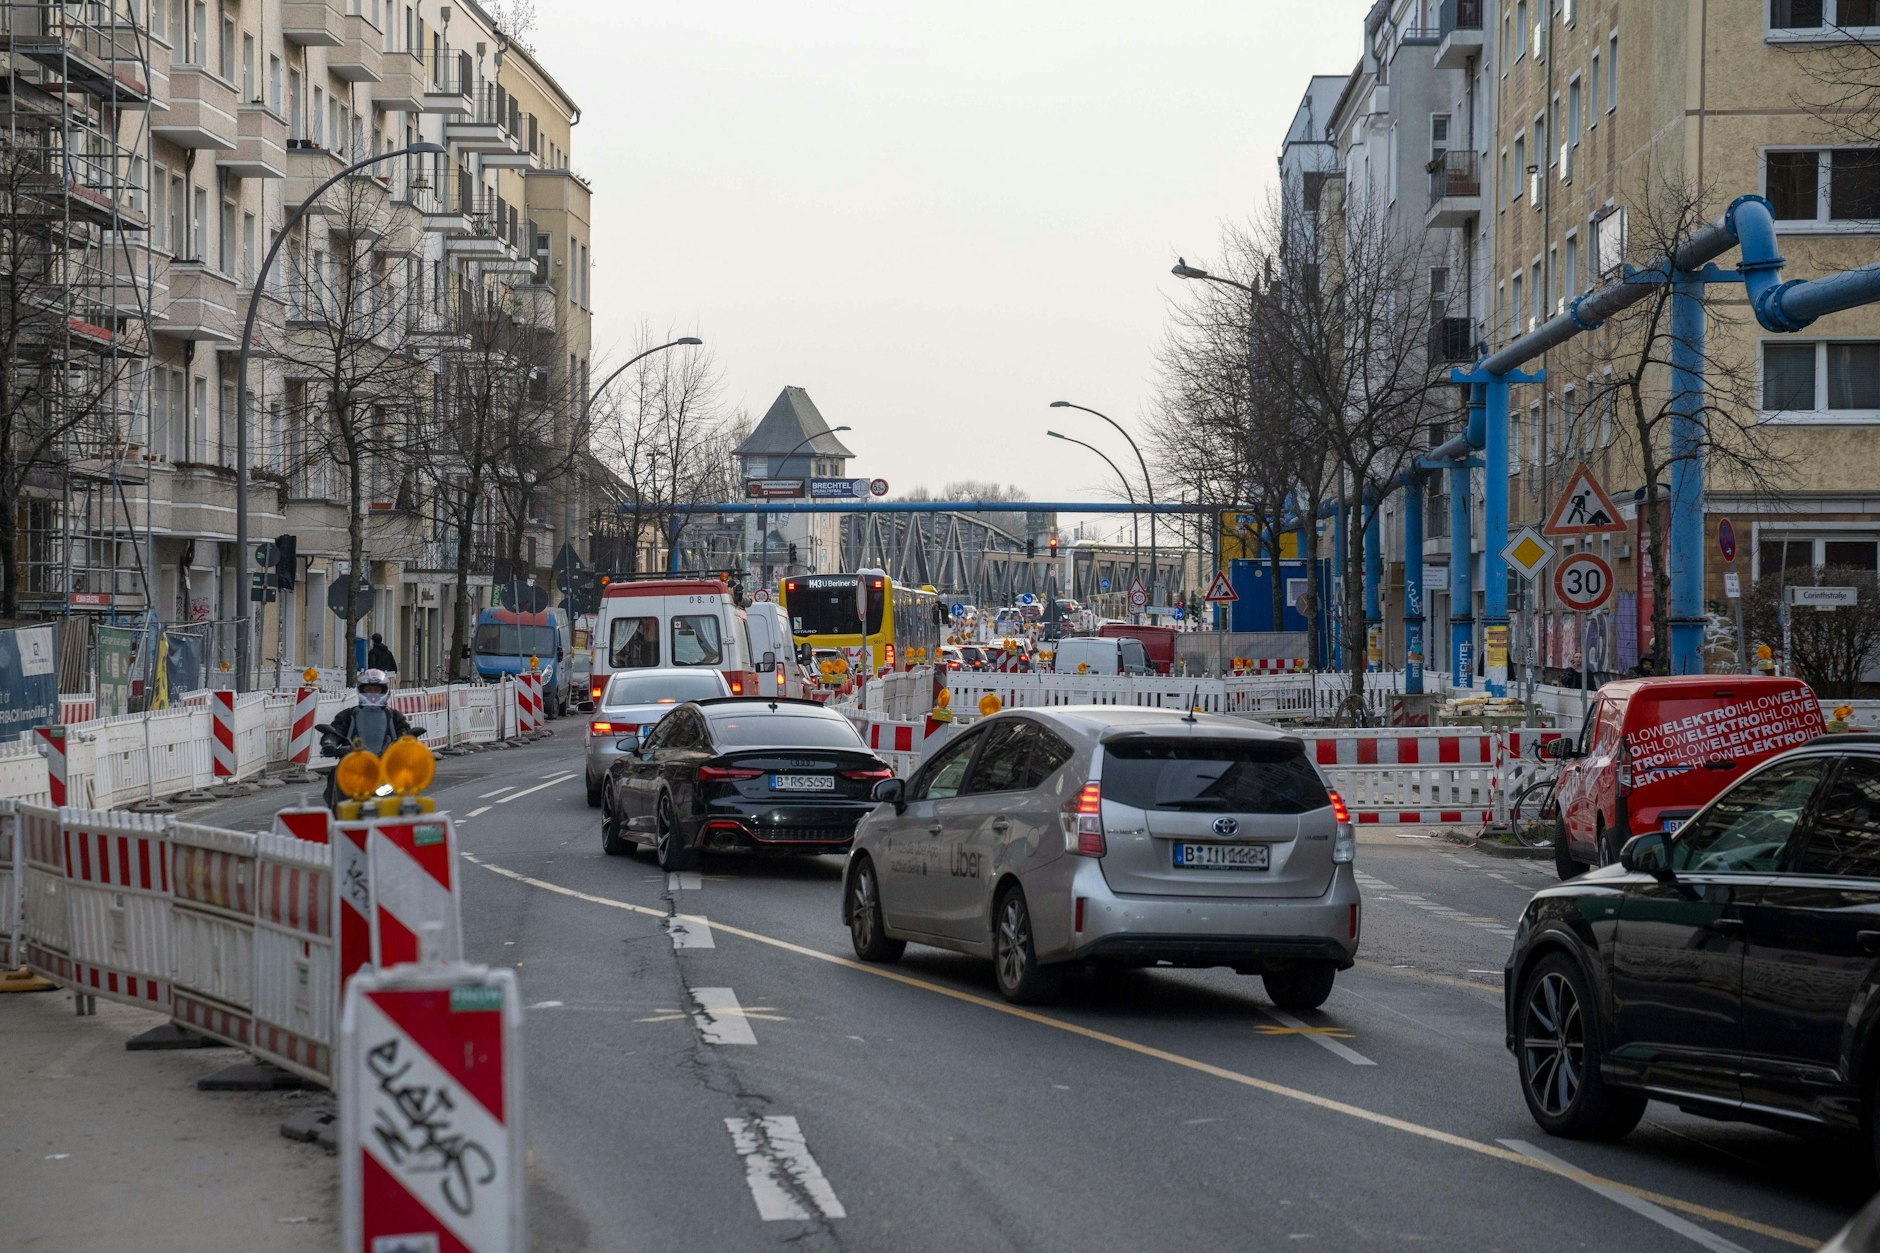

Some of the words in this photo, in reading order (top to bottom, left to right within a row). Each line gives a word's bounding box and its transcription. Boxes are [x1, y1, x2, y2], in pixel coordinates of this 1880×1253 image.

[809, 579, 822, 588] M43
[1567, 569, 1601, 595] 30
[951, 843, 982, 878] Uber
[1185, 846, 1195, 862] B
